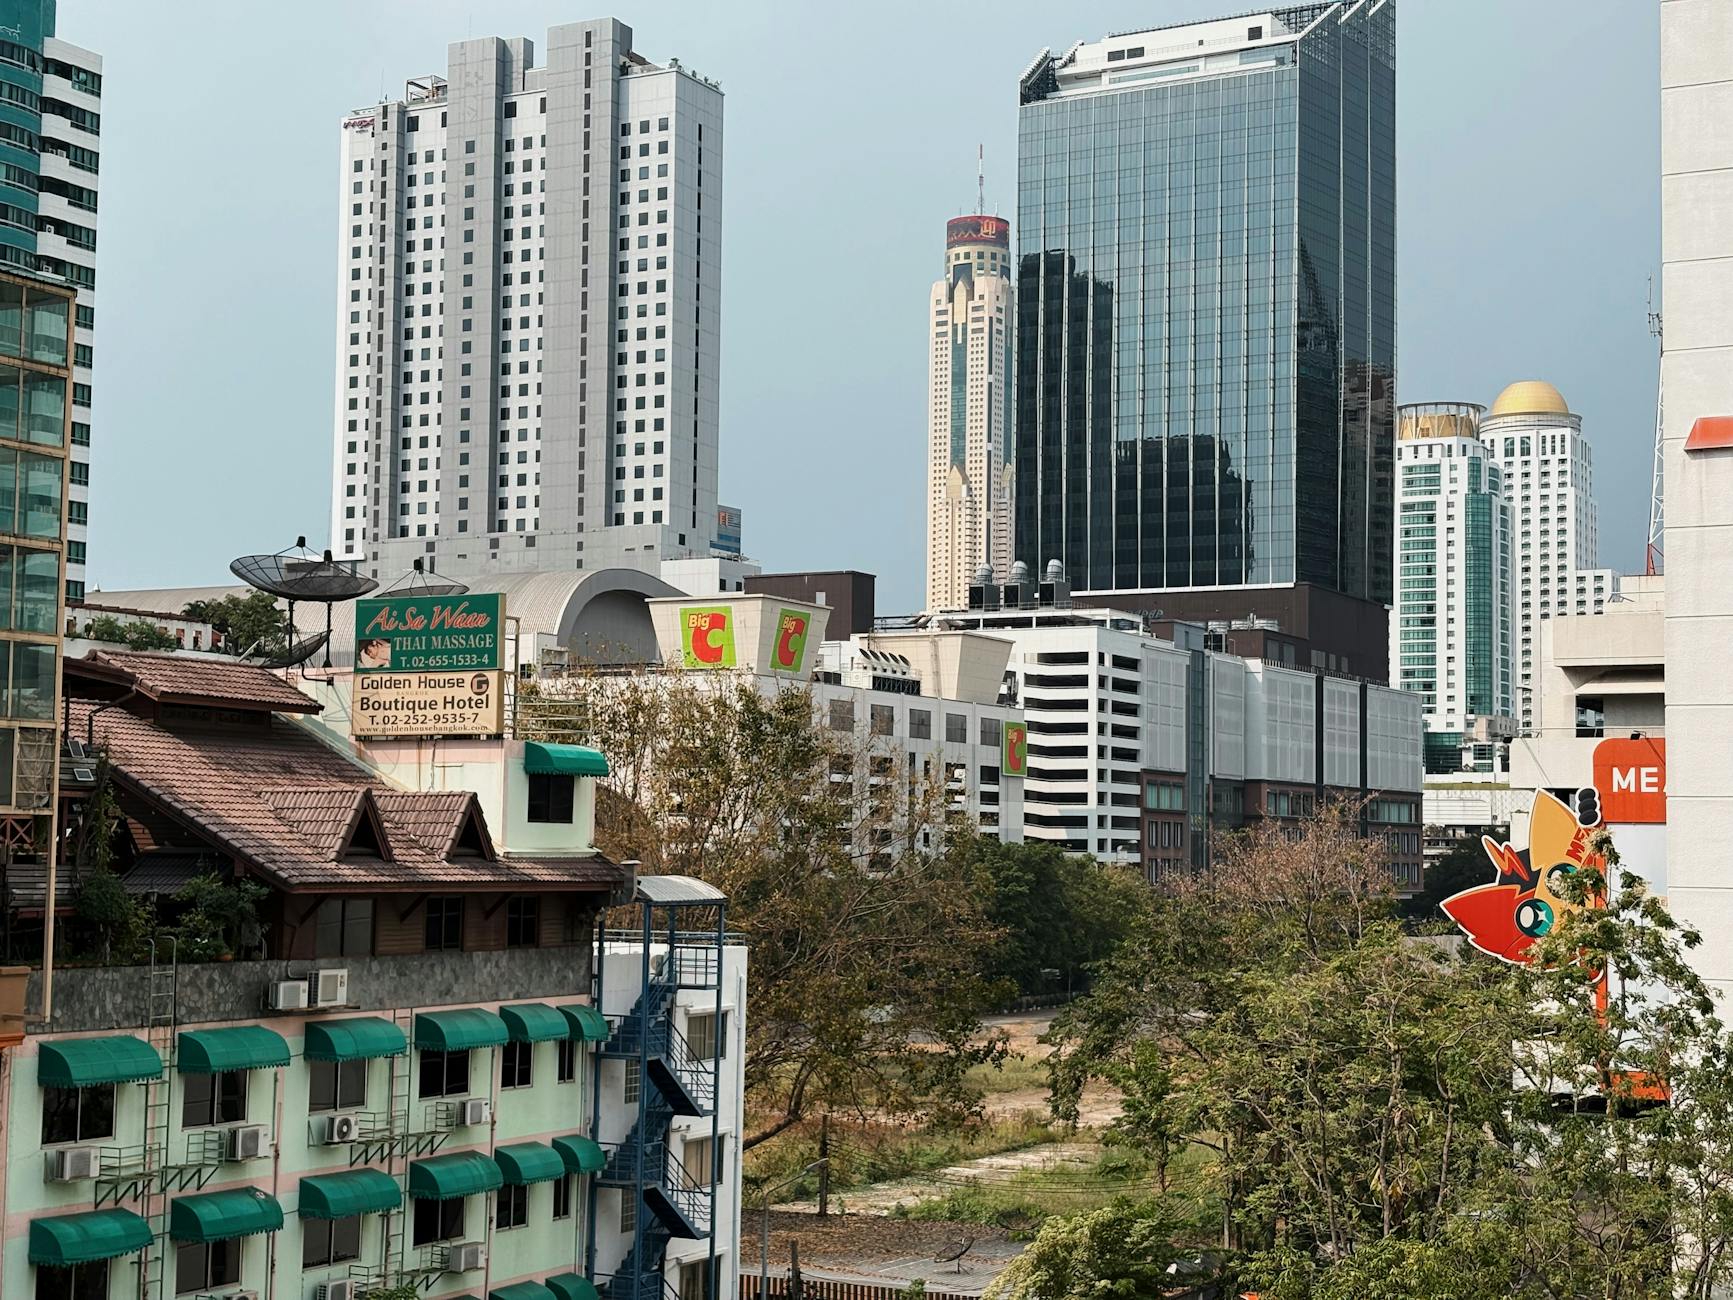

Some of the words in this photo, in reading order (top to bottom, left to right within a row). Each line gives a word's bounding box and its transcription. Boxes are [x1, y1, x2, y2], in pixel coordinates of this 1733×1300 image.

[365, 606, 399, 634] Ai
[400, 606, 427, 630] Sa
[430, 601, 491, 630] Waan
[688, 613, 711, 630] Big
[782, 615, 796, 633] Big
[394, 636, 426, 651] THAI
[431, 633, 494, 650] MASSAGE
[691, 612, 727, 664] C
[777, 617, 806, 667] C
[400, 656, 411, 668] T.
[412, 653, 489, 668] 02-655-1533-4
[360, 676, 411, 690] Golden
[418, 675, 465, 689] House
[360, 696, 438, 714] Boutique
[443, 694, 489, 710] Hotel
[369, 715, 379, 726] T.
[382, 713, 479, 726] 02-252-9535-7
[1008, 728, 1024, 771] C
[1612, 766, 1666, 793] ME
